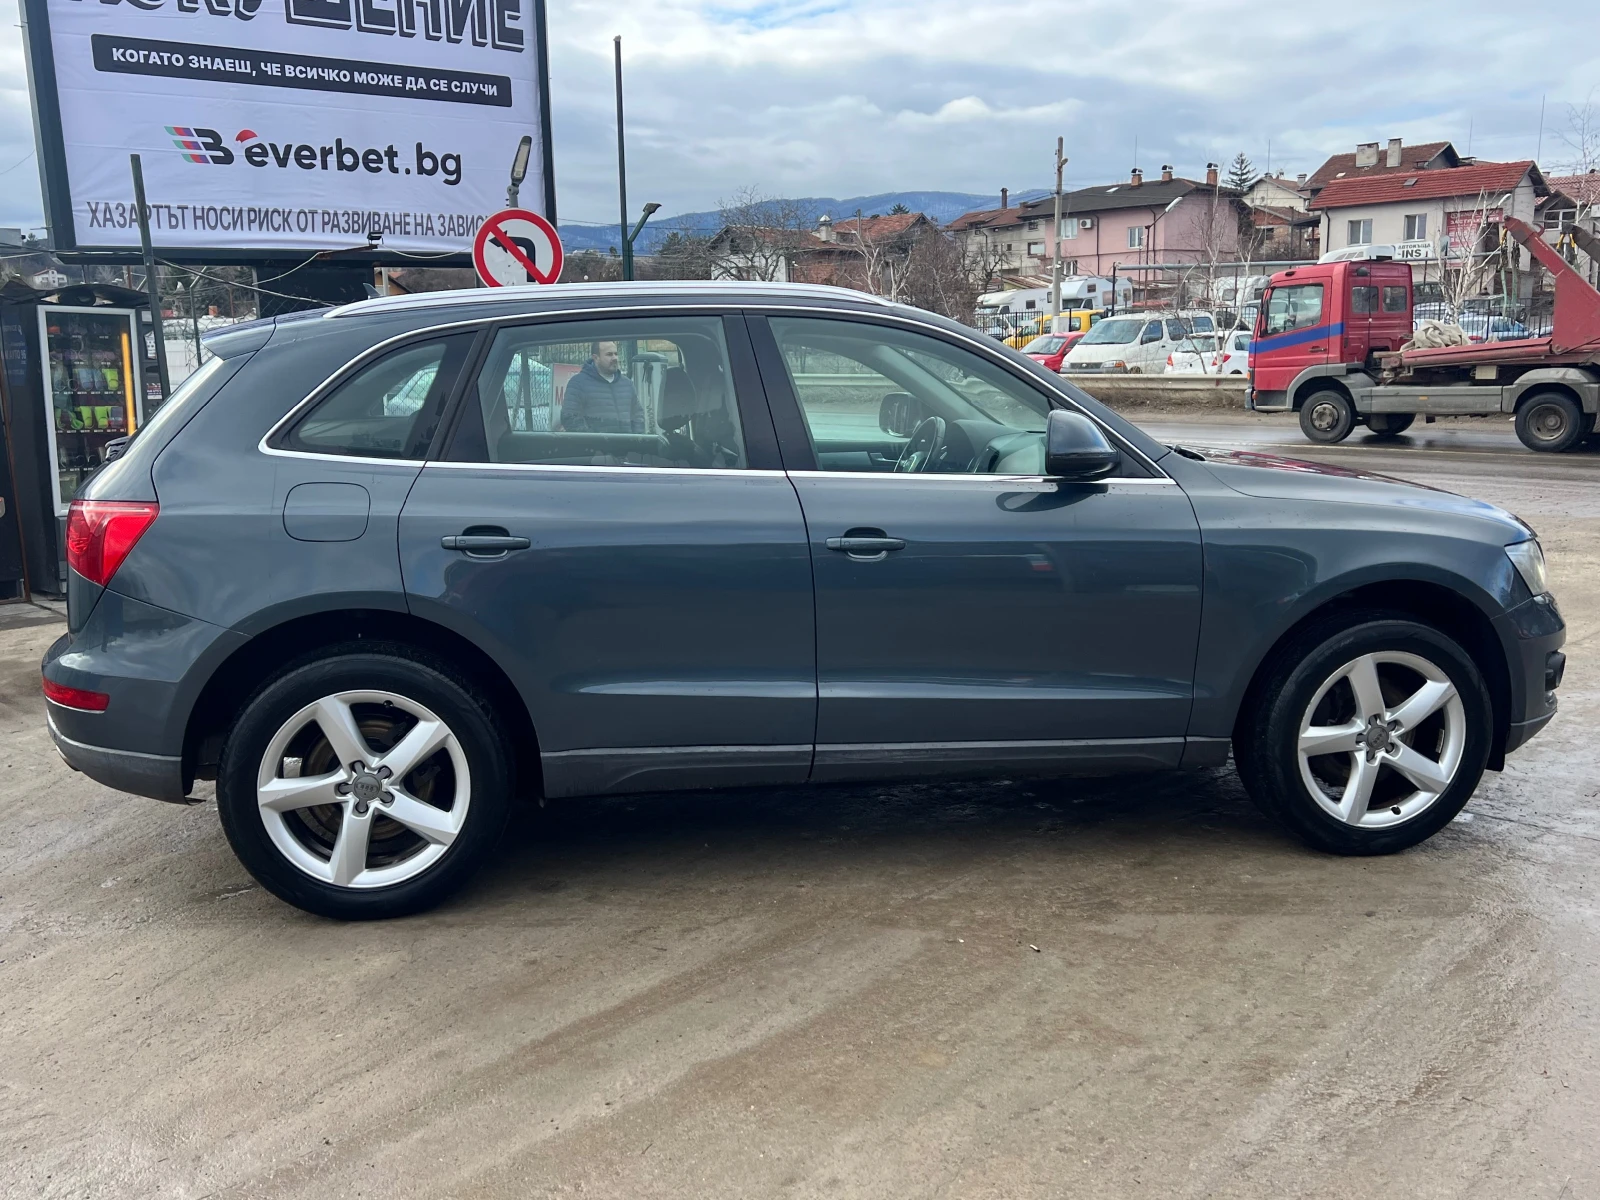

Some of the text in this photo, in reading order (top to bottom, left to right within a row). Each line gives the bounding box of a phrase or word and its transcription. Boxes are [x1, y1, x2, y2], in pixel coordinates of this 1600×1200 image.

[112, 48, 498, 97] КОГАТО ЗНАЕШ, ЧЕ ВСИЧКО МОЖЕ ДА СЕ СЛУЧИ
[193, 205, 243, 231] НОСИ
[247, 207, 293, 232] РИСК
[297, 209, 318, 233] ОТ
[321, 210, 411, 236] РАЗВИВАНЕ
[414, 213, 435, 236] НА
[438, 213, 488, 237] ЗАВИС
